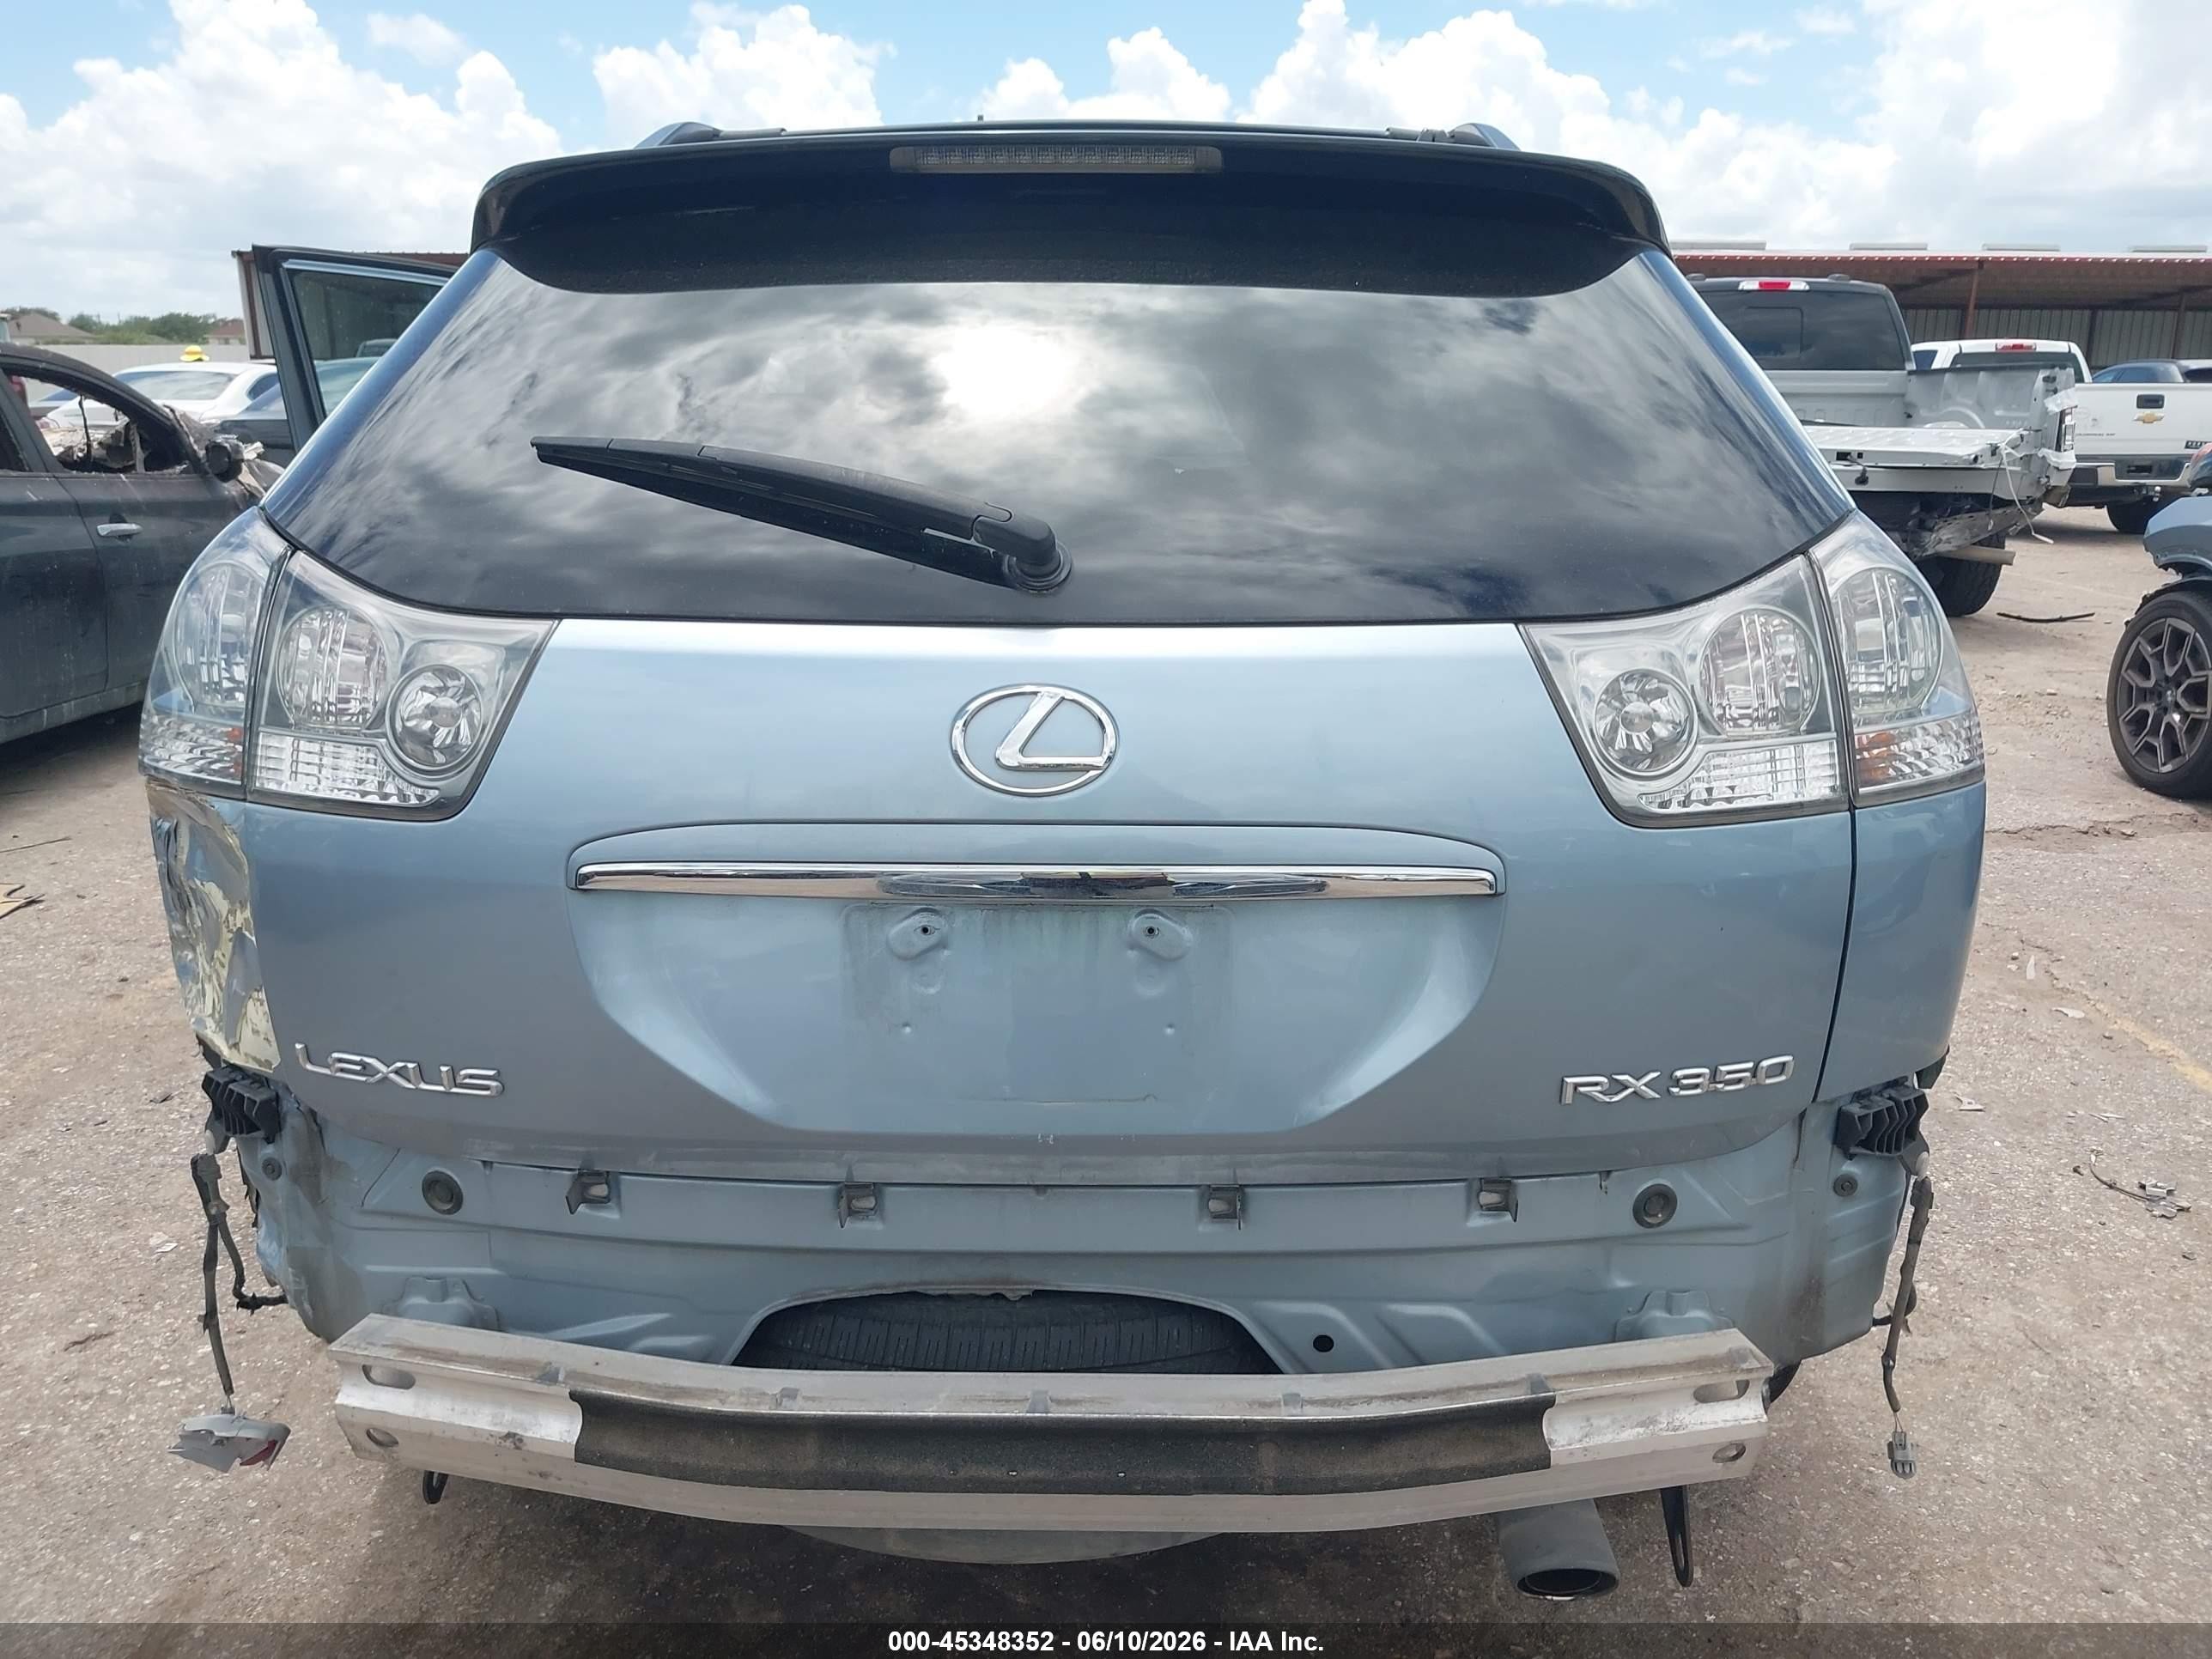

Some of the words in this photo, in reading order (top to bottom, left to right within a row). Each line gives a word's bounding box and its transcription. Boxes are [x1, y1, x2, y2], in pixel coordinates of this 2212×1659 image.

[295, 1042, 503, 1097] LEXUS
[1559, 1071, 1662, 1105] RX
[1668, 1054, 1796, 1097] 350
